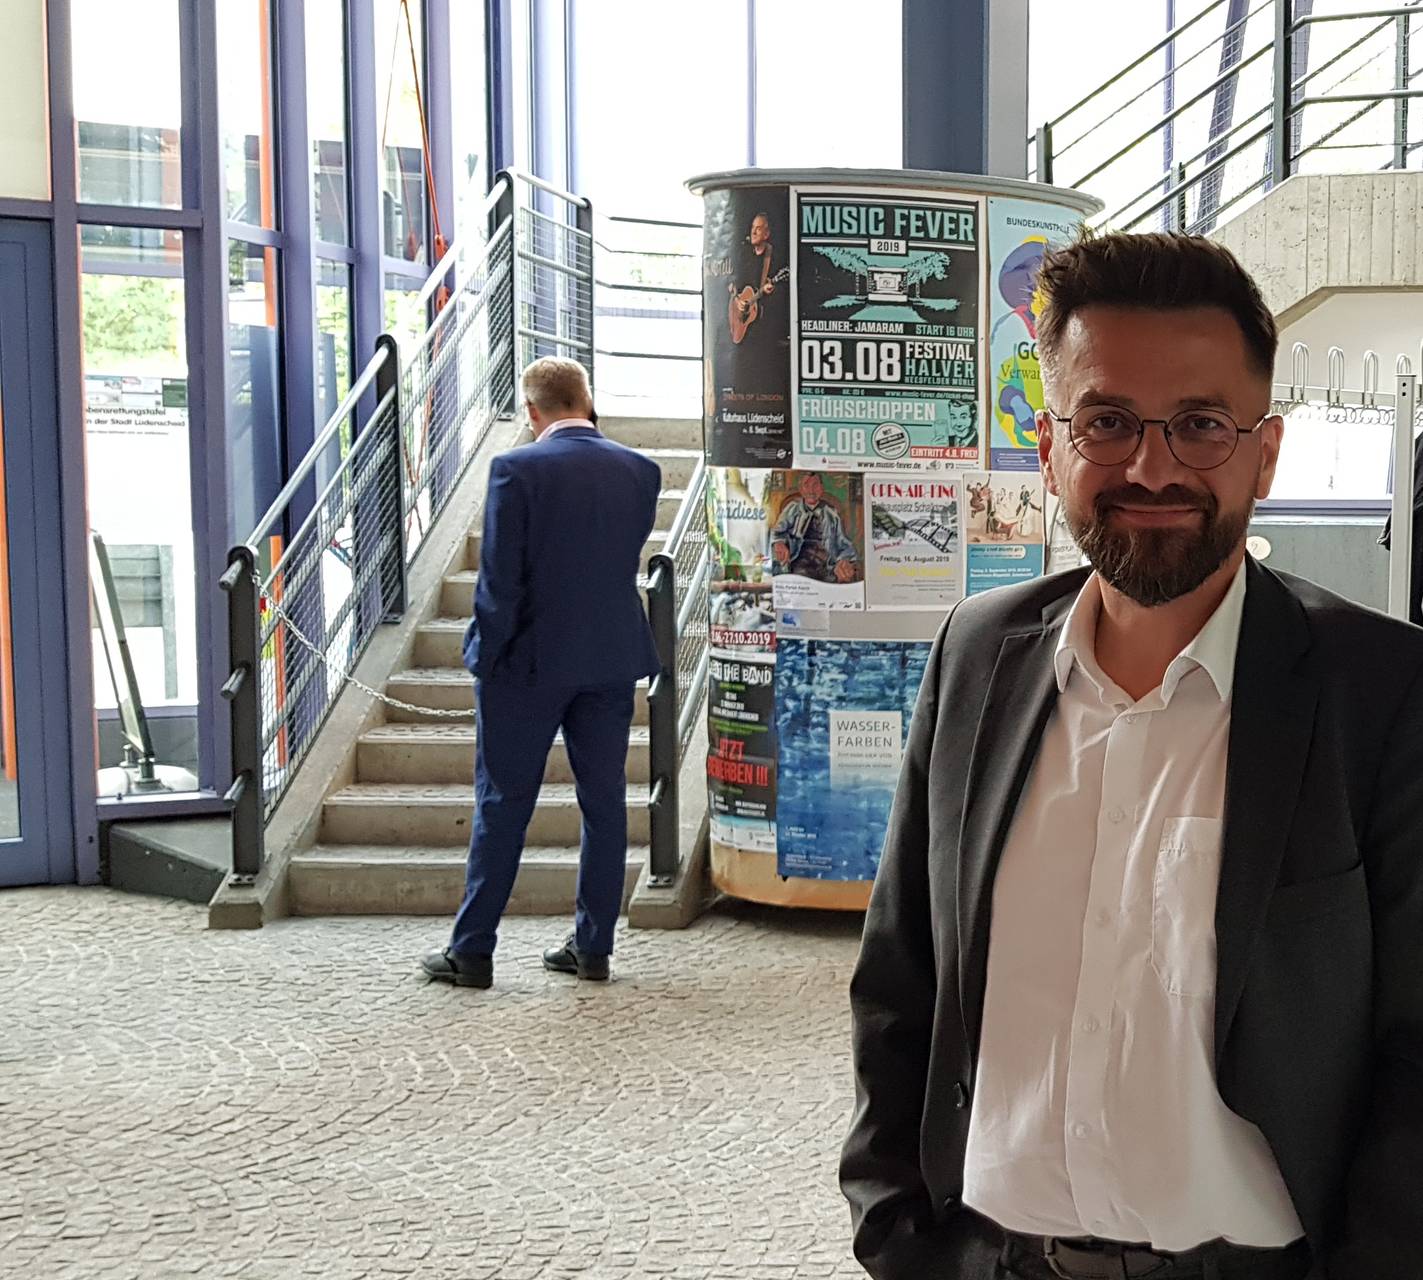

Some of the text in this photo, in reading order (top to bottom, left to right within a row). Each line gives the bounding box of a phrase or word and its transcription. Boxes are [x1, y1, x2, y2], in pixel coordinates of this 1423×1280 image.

[801, 205, 976, 242] MUSIC FEVER
[877, 241, 900, 252] 2019
[801, 320, 853, 333] HEADLINER:
[855, 321, 904, 335] JAMARAM
[916, 325, 944, 337] START
[957, 326, 975, 339] UHR
[801, 339, 901, 382] 03.08
[905, 341, 974, 361] FESTIVAL
[905, 358, 976, 379] HALVER
[801, 396, 936, 421] FRÜHSCHOPPEN
[801, 426, 866, 455] 04.08
[911, 447, 944, 458] EINTRITT
[914, 555, 935, 564] August
[742, 664, 772, 686] BAND
[837, 720, 896, 731] WASSER-
[837, 735, 892, 747] FARBEN
